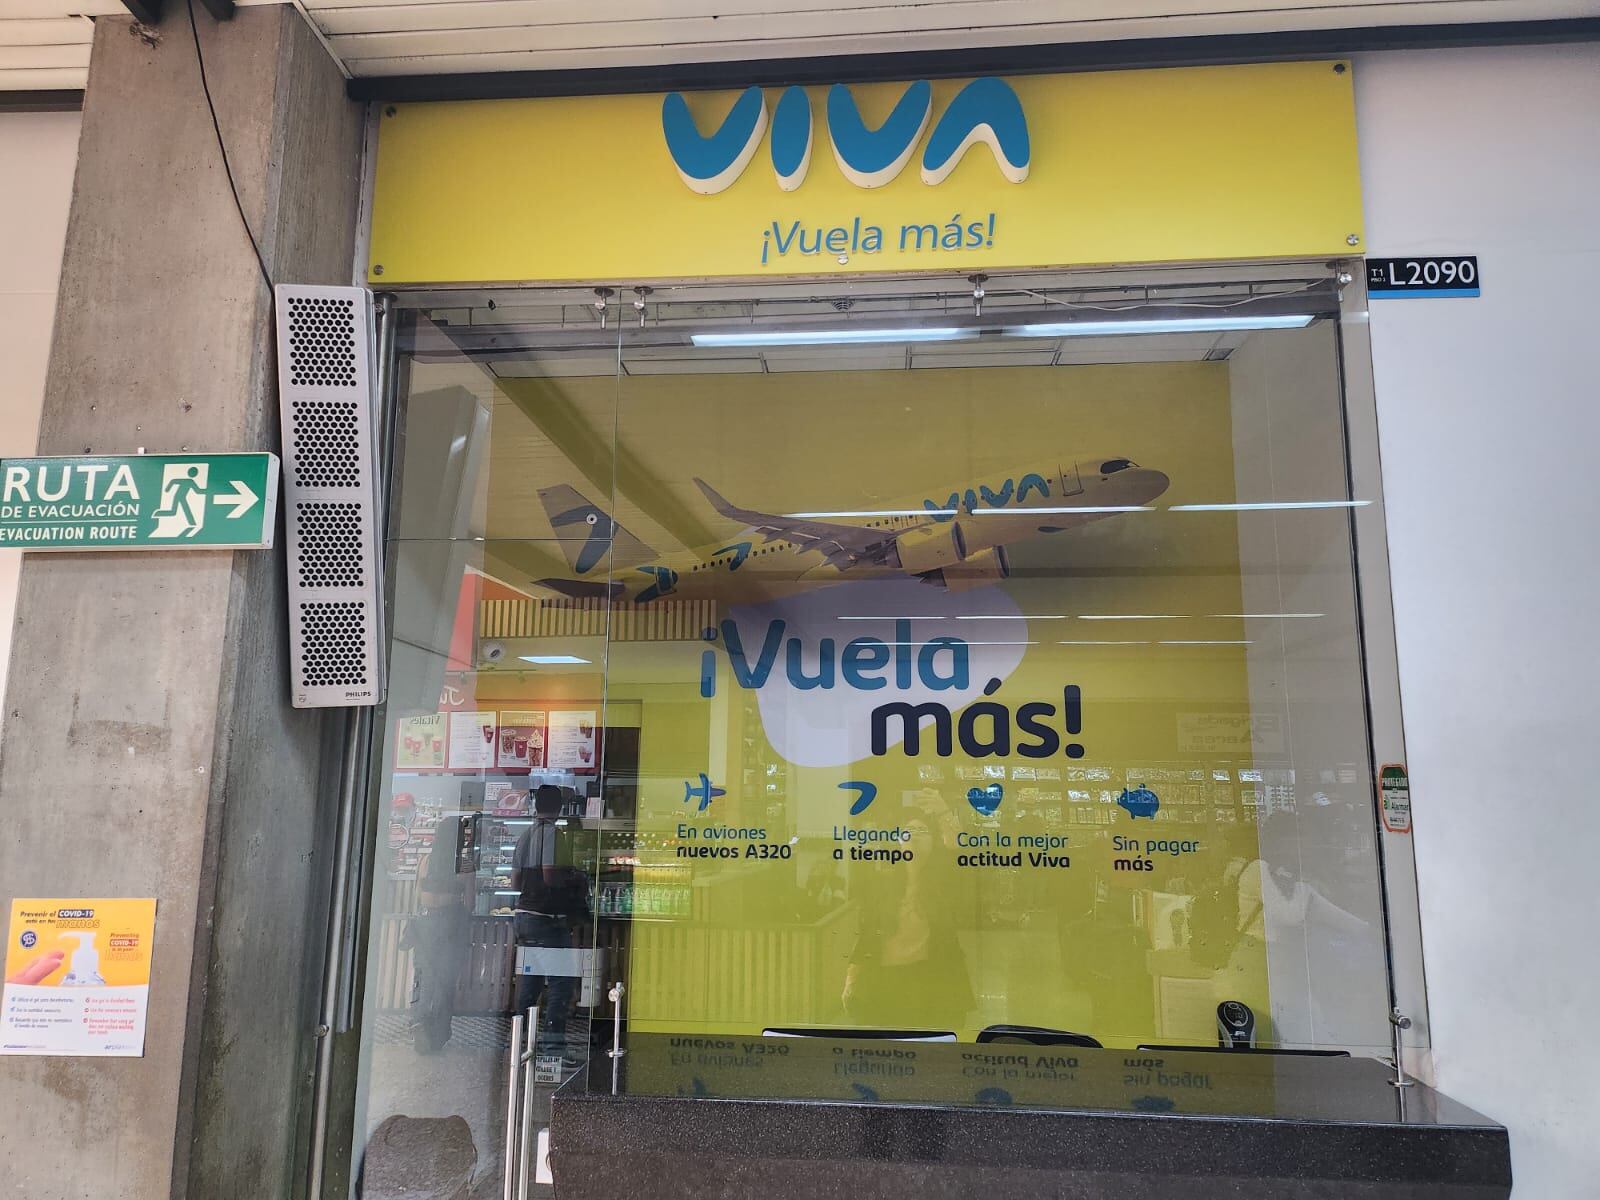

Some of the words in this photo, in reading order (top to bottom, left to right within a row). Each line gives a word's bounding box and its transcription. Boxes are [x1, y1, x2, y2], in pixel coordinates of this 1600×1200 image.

[662, 76, 1031, 195] VIVA
[760, 216, 883, 265] ¡Vuela
[898, 212, 997, 252] más!
[1370, 268, 1384, 277] T1
[1389, 261, 1475, 286] L2090
[3, 464, 141, 502] RUTA
[923, 472, 1051, 523] VIVA
[1, 505, 23, 519] DE
[28, 501, 140, 518] EVACUACIÓN
[0, 526, 84, 541] EVACUATION
[90, 525, 138, 540] ROUTE
[699, 618, 970, 699] ¡Vuela
[870, 677, 1086, 759] más!
[677, 823, 697, 840] En
[702, 823, 767, 842] aviones
[833, 825, 912, 845] Llegando
[956, 832, 990, 848] Con
[996, 831, 1012, 848] la
[1017, 833, 1069, 853] mejor
[676, 845, 739, 860] nuevos
[744, 844, 792, 860] A320
[833, 848, 843, 861] a
[849, 844, 914, 865] tiempo
[1112, 835, 1141, 852] Sin
[1146, 838, 1199, 857] pagar
[957, 851, 1022, 868] actitud
[1027, 852, 1071, 868] Viva
[1113, 854, 1154, 873] más
[20, 910, 48, 918] Prevenir
[59, 909, 94, 918] COVID-19
